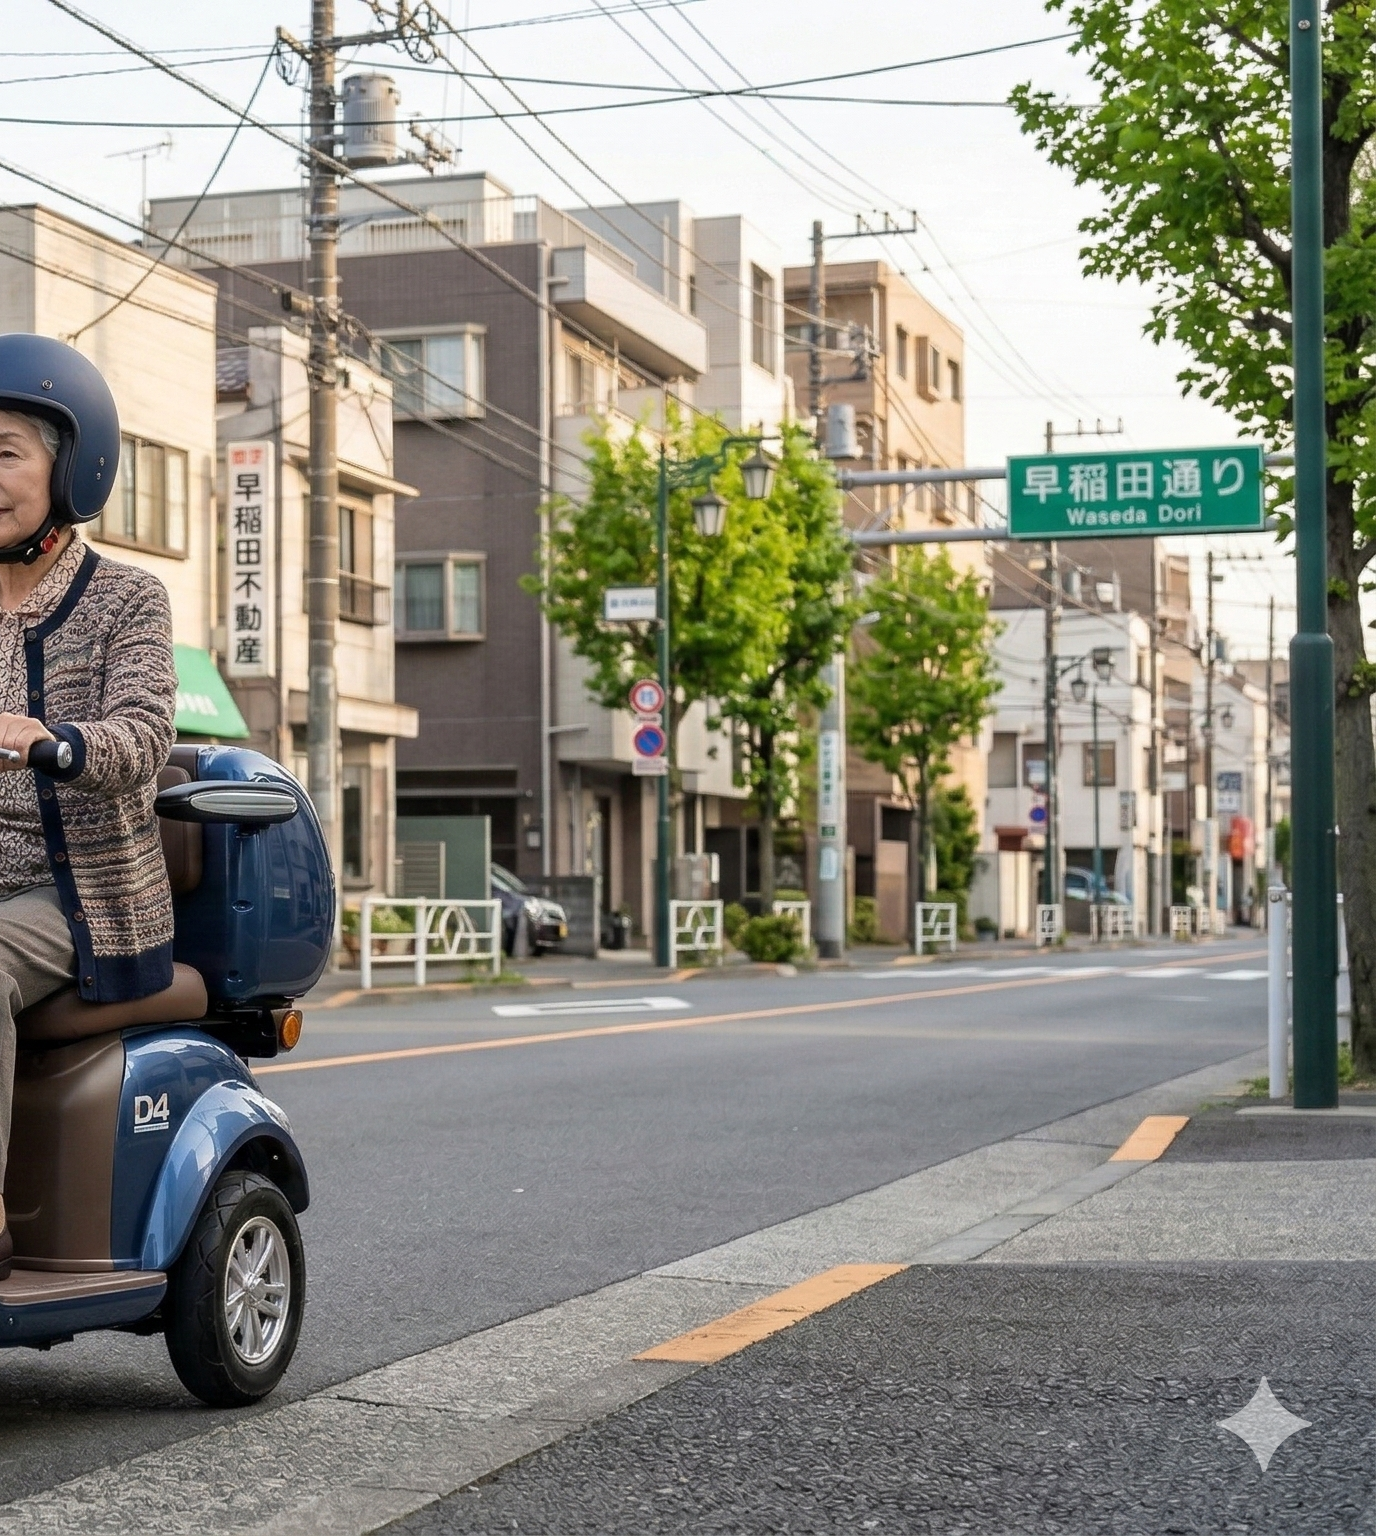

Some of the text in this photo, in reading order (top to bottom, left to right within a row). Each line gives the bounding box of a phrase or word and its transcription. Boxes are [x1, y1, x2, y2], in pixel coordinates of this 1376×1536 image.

[1022, 457, 1245, 504] 早稲田通り
[1067, 503, 1202, 526] Waseda Dori
[234, 473, 262, 664] 早稲田不動産
[135, 1093, 170, 1125] D4
